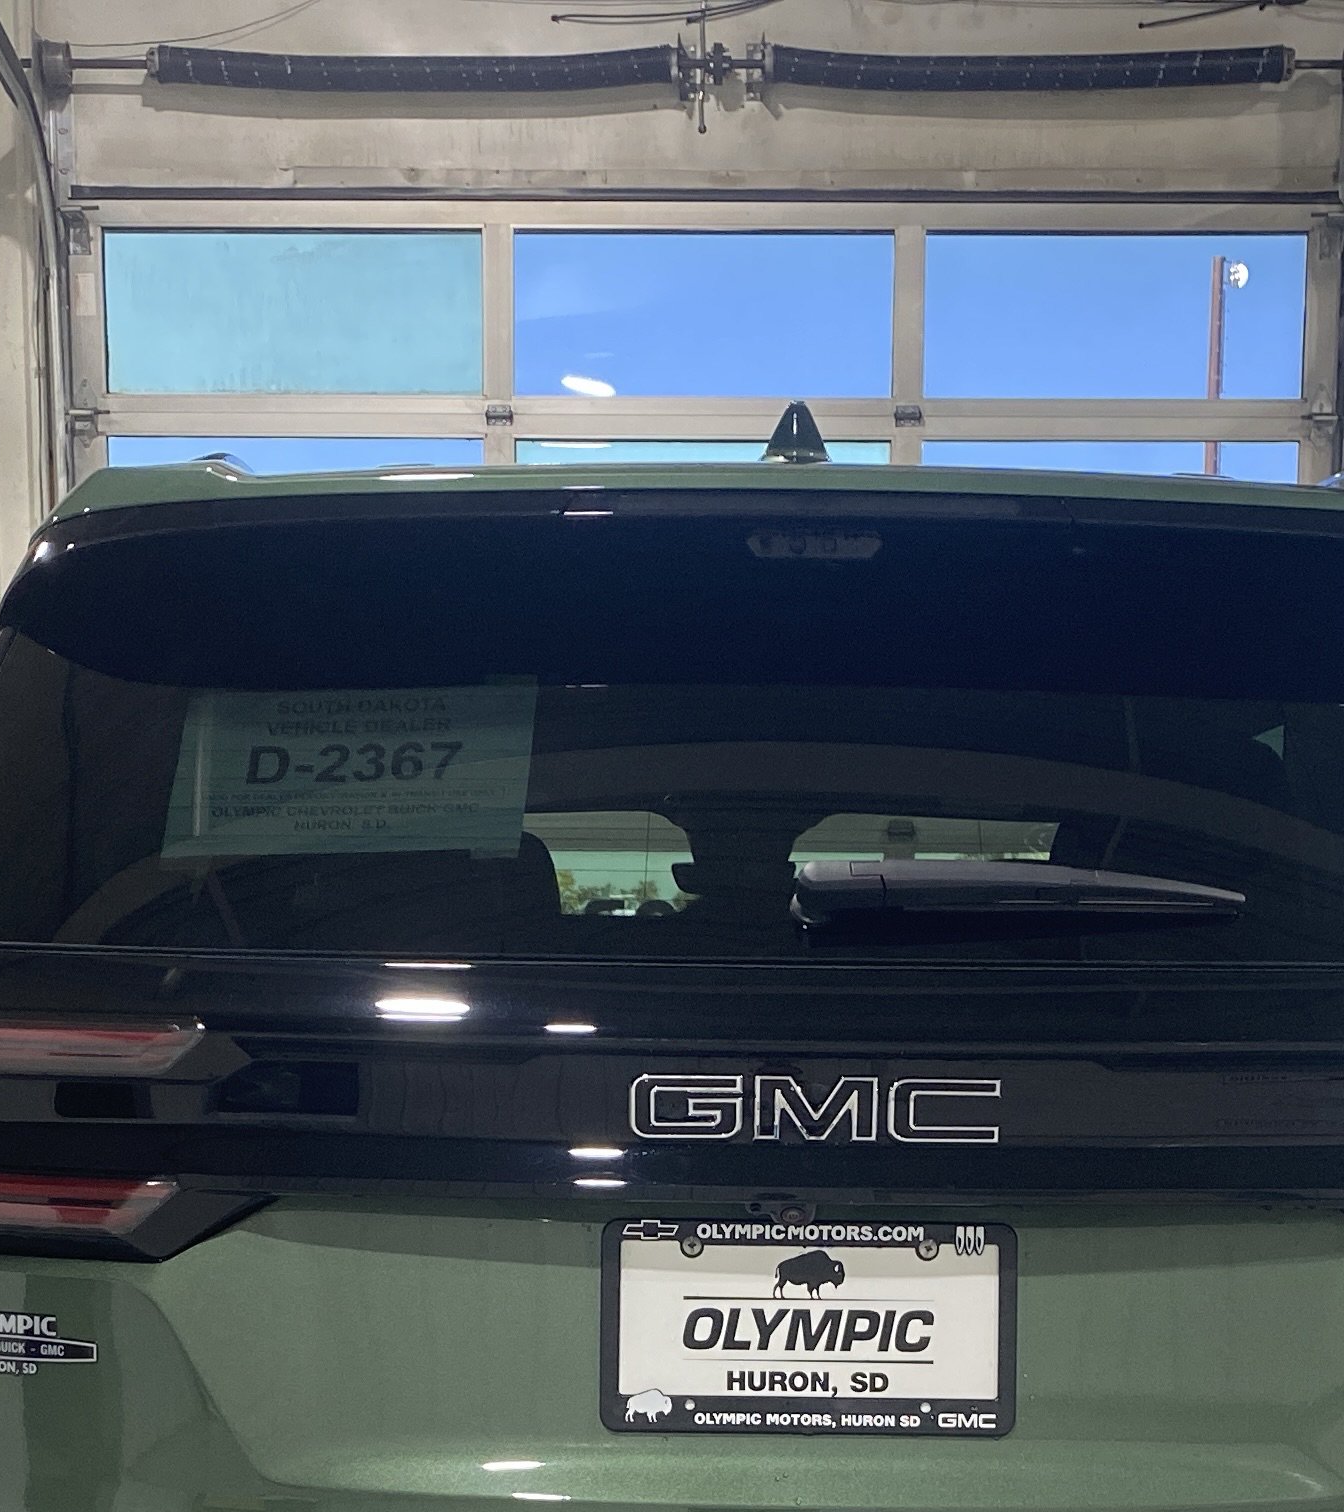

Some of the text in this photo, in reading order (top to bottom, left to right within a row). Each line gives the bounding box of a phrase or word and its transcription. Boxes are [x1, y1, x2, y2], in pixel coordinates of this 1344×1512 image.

[276, 697, 448, 715] SOUTH DAKOTA
[266, 717, 452, 736] VEHICLE DEALER
[246, 741, 463, 785] D-2367
[628, 1073, 1002, 1143] GMC
[696, 1223, 924, 1242] OLYMPICMOTORS.COM
[682, 1307, 935, 1353] OLYMPIC
[40, 1343, 65, 1356] GMC
[22, 1362, 37, 1375] SD
[726, 1369, 889, 1398] HURON, SD
[694, 1412, 921, 1429] OLYMPIC MOTORS, HURON SD
[937, 1413, 997, 1429] GMC
